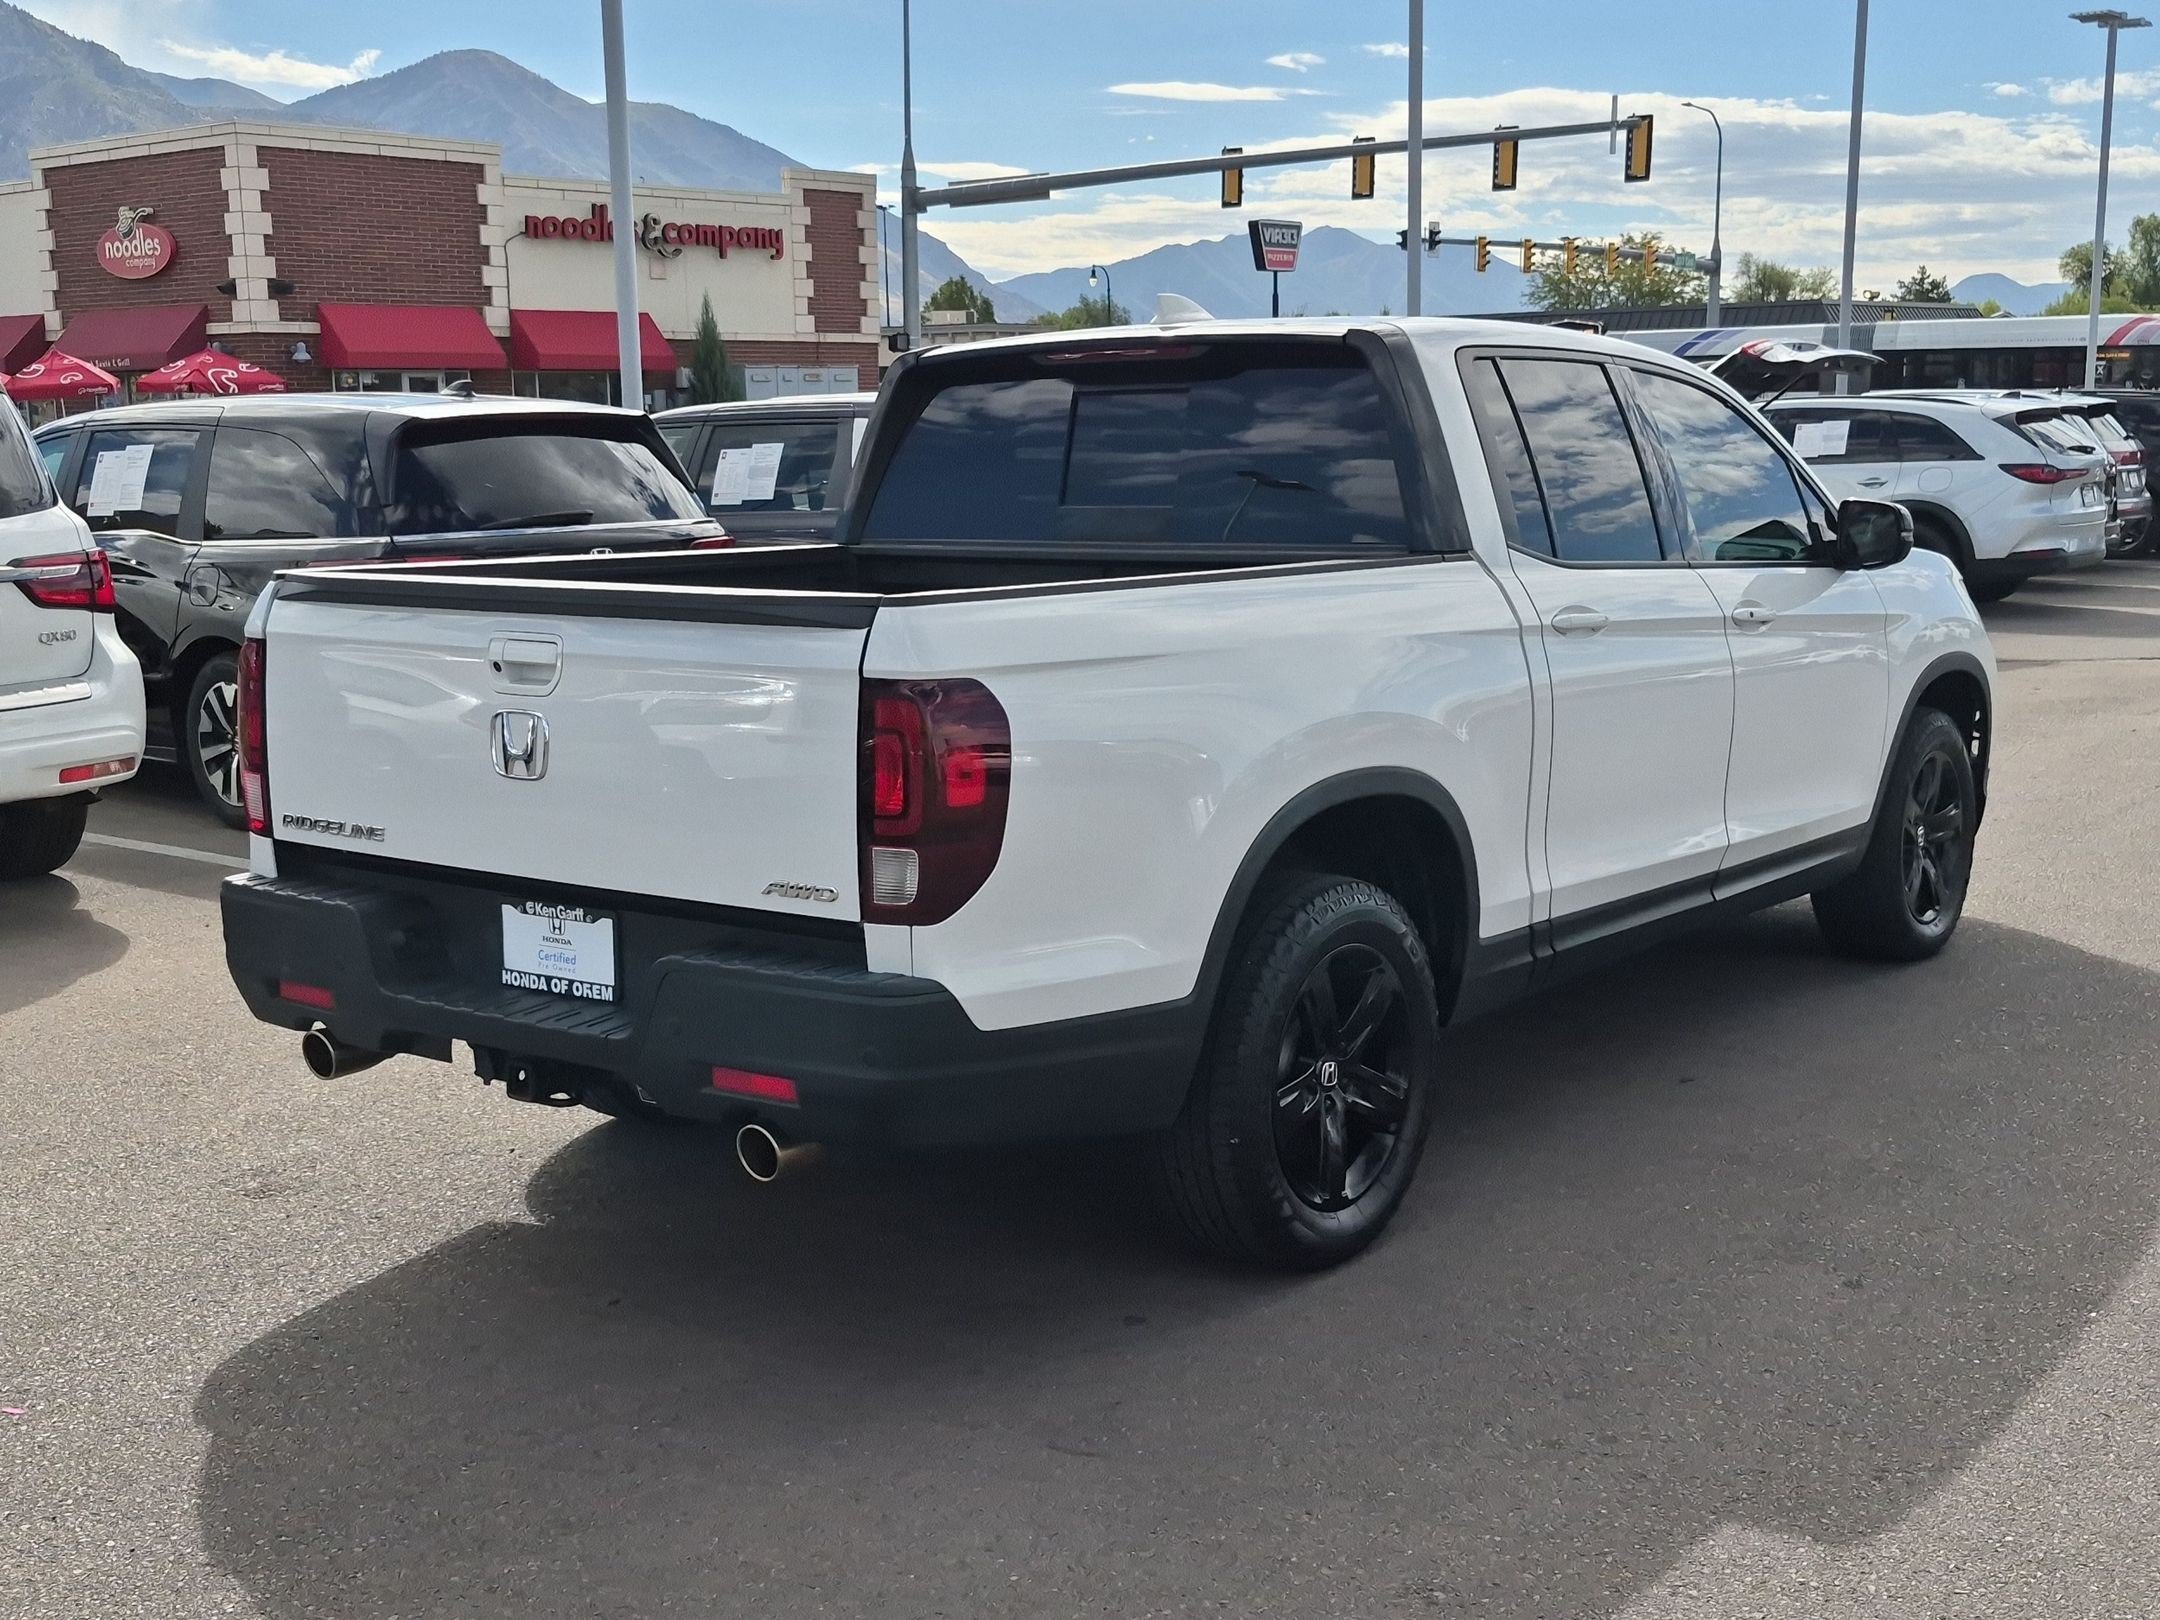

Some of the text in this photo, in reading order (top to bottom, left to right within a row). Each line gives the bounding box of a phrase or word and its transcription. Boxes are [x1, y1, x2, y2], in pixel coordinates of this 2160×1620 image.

[104, 228, 161, 259] noodles
[525, 203, 785, 260] noodl & company
[125, 256, 156, 269] company
[282, 813, 385, 842] RIDGELINE
[761, 879, 839, 903] AWD
[535, 902, 584, 922] Ken Garff
[542, 935, 572, 946] HONDA
[538, 949, 577, 966] Certified
[502, 969, 614, 1002] HONDA OF OREM
